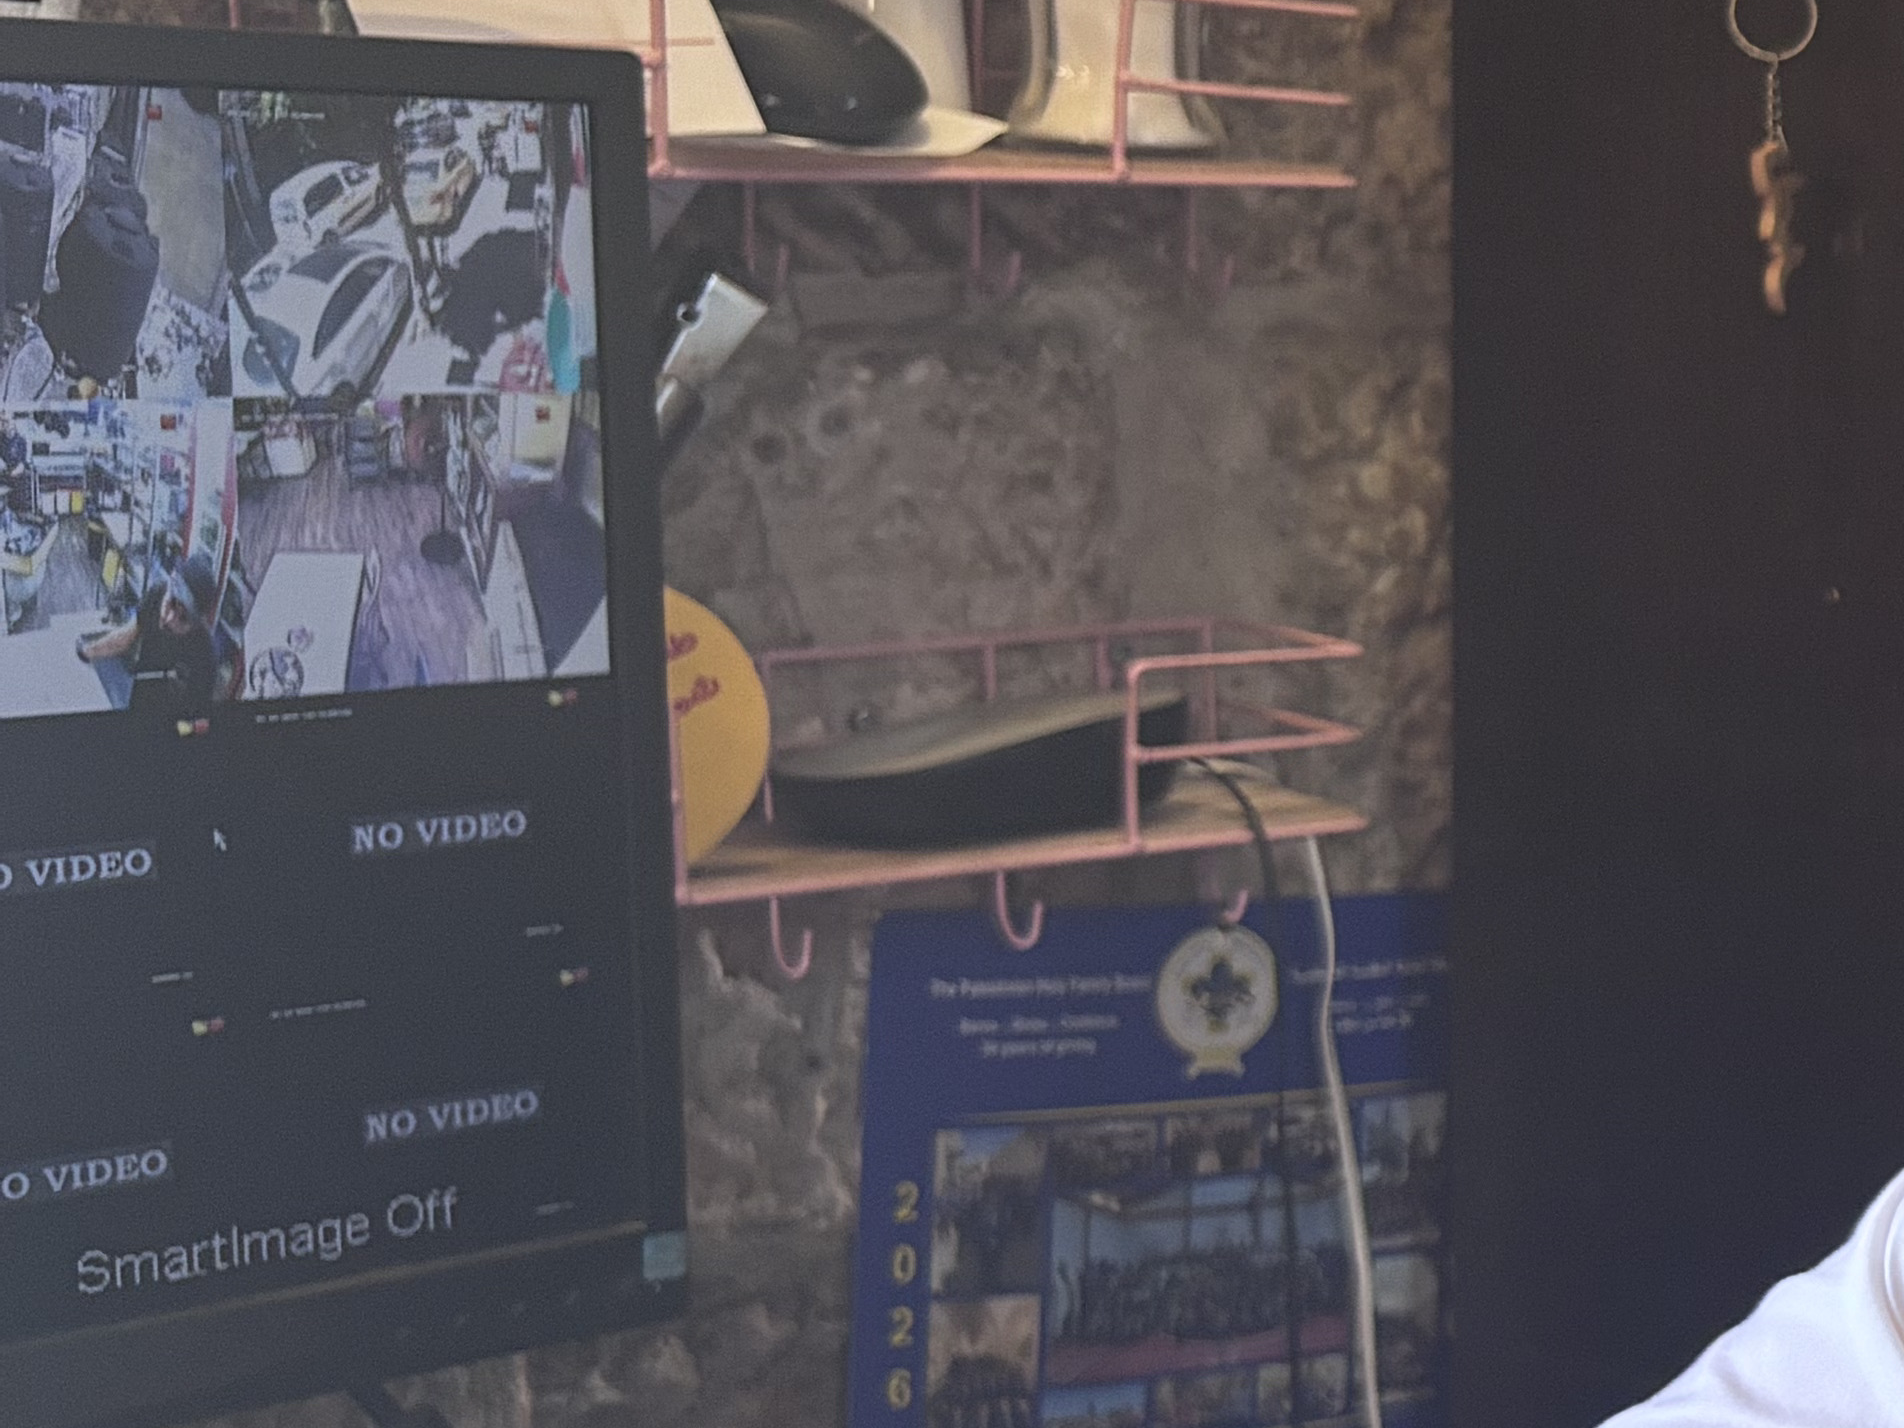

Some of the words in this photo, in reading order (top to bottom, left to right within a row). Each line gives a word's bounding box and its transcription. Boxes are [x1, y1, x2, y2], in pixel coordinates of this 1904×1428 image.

[350, 824, 404, 854] NO
[416, 809, 528, 846] VIDEO
[26, 847, 153, 886] VIDEO
[363, 1111, 417, 1143] NO
[427, 1090, 541, 1132] VIDEO
[42, 1148, 169, 1192] VIDEO
[77, 1212, 372, 1294] SmartImage
[385, 1186, 457, 1239] Off
